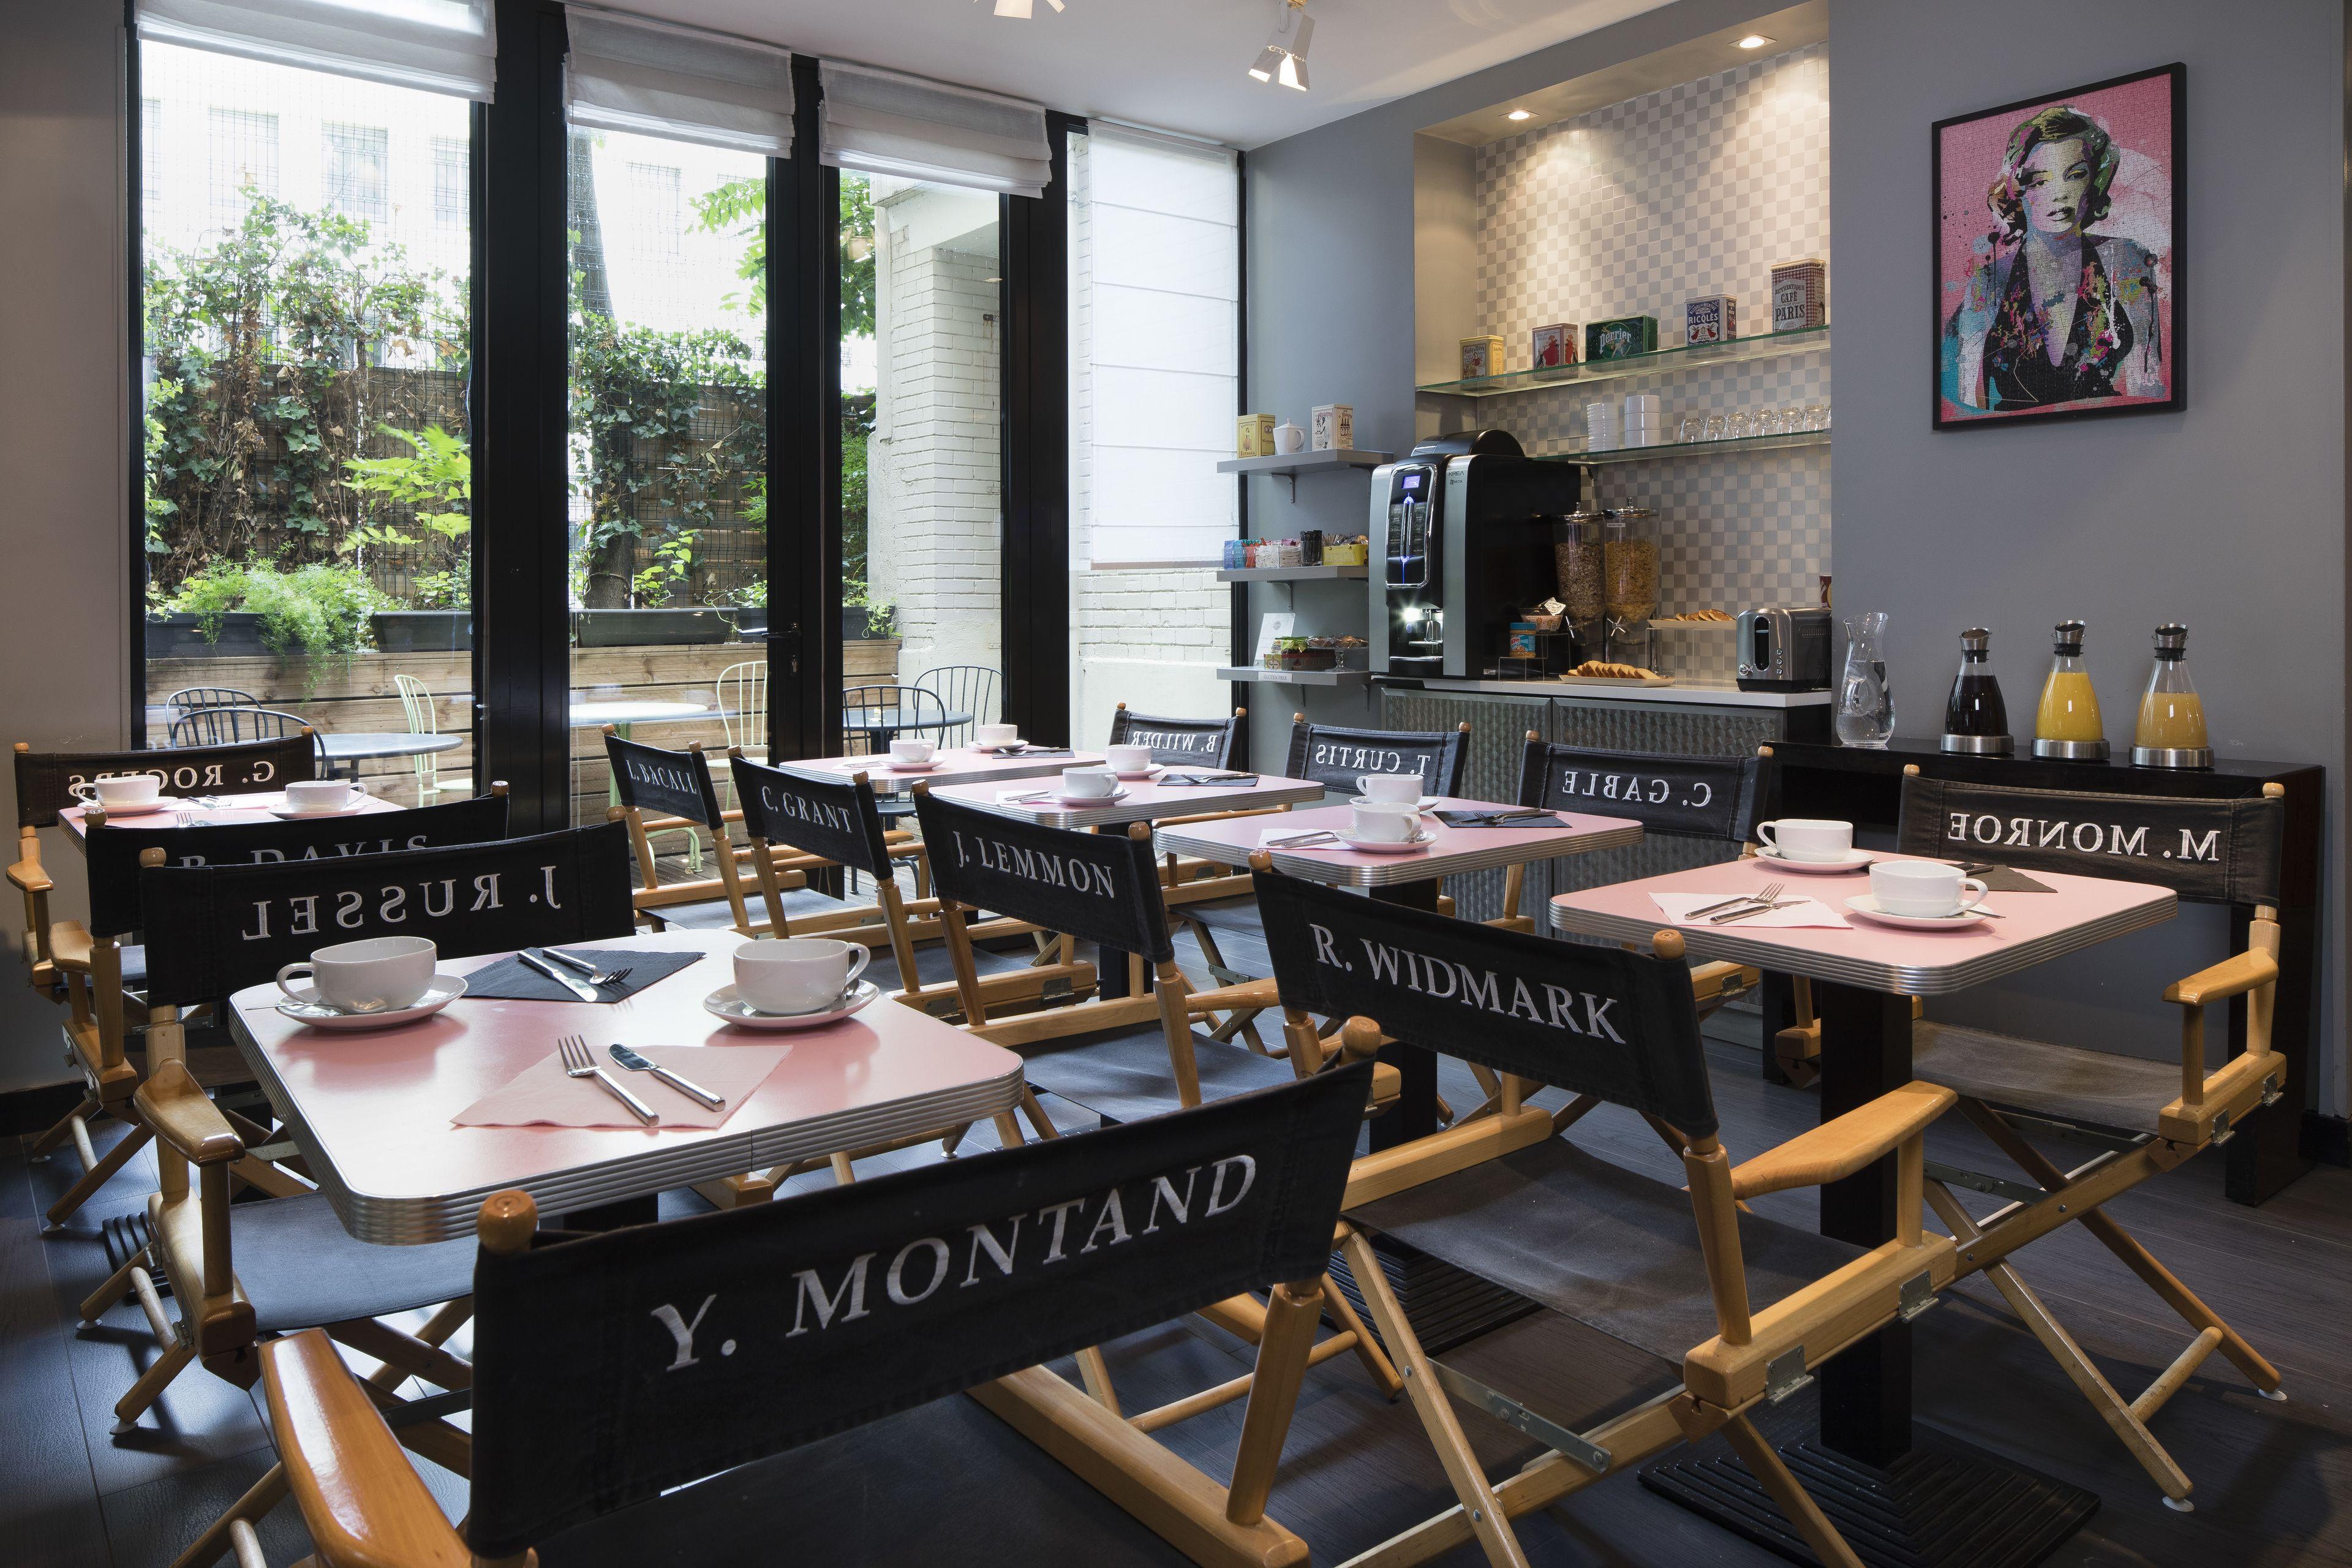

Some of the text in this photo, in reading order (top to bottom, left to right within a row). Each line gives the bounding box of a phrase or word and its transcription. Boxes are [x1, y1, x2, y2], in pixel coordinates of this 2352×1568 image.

[1774, 284, 1805, 295] AUTHENTIQUE
[1781, 290, 1798, 304] CAFÉ
[1689, 313, 1718, 324] RICQLÈS
[1774, 304, 1805, 322] PARIS
[625, 759, 698, 795] L. BACALL
[761, 785, 853, 834] C. GRANT
[952, 831, 1115, 899] J. LEMMON
[1310, 923, 1626, 1044] R. WIDMARK
[650, 1154, 1257, 1372] Y. MONTAND
